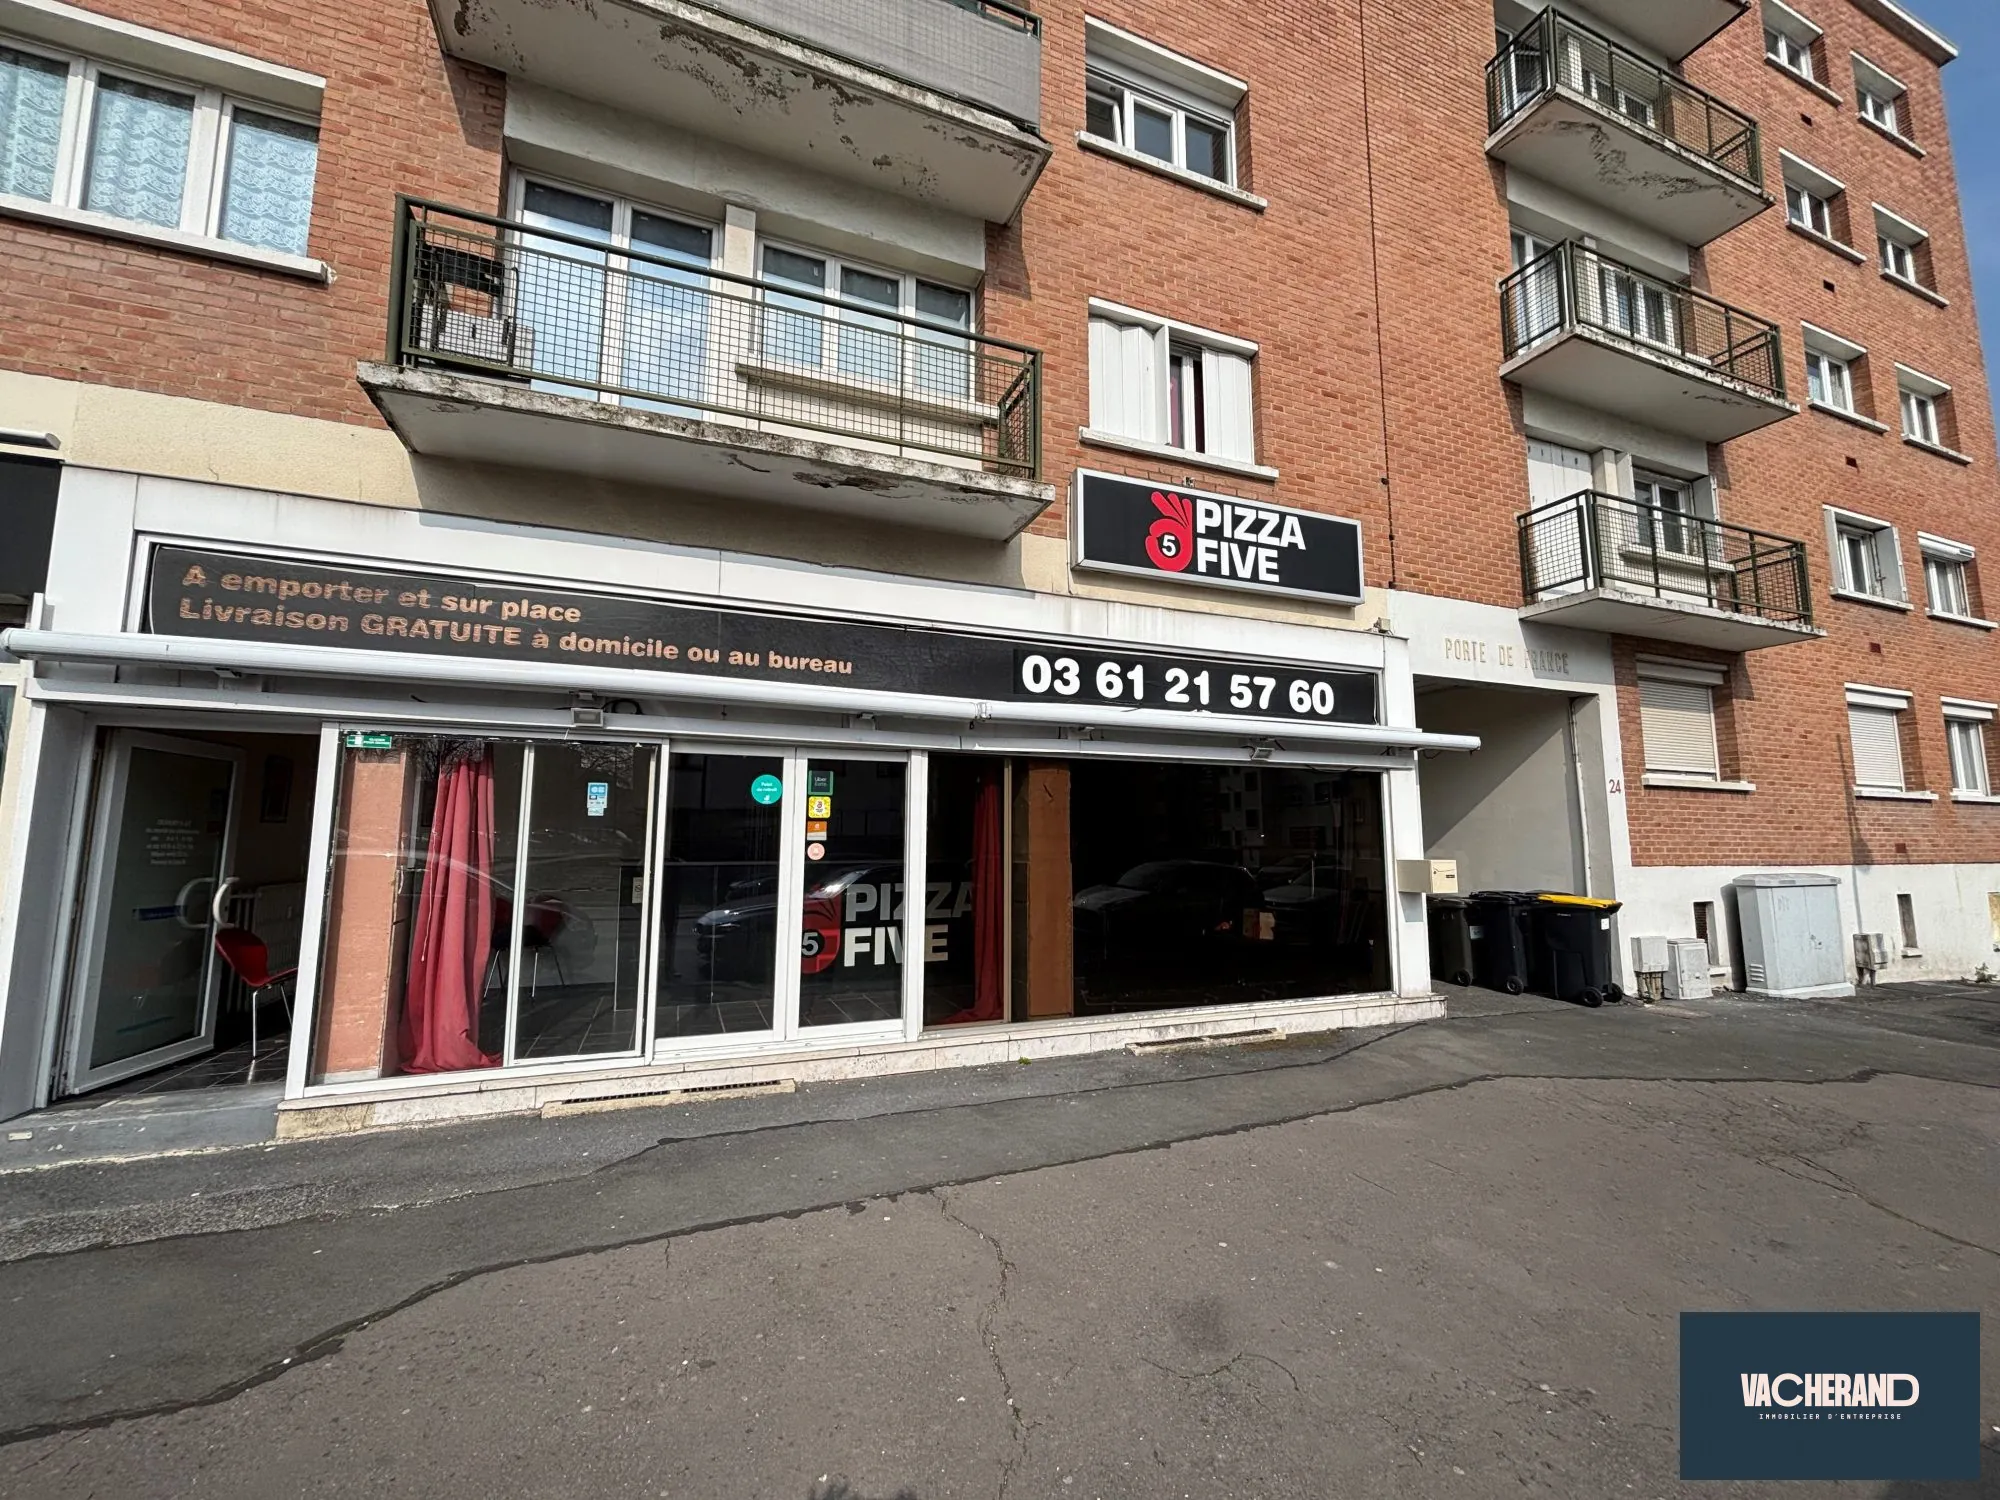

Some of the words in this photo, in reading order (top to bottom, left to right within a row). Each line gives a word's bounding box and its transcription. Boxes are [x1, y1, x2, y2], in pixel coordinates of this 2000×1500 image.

[1161, 534, 1177, 557] 5
[1196, 498, 1307, 551] PIZZA
[1196, 537, 1280, 583] FIVE
[182, 565, 207, 588] A
[220, 573, 390, 604] emporter
[398, 589, 432, 609] et
[441, 595, 494, 615] sur
[501, 599, 583, 623] place
[179, 598, 350, 632] Livraison
[360, 613, 522, 646] GRATUITE
[531, 627, 550, 649] à
[559, 632, 680, 661] domicile
[687, 646, 720, 664] ou
[728, 648, 760, 667] au
[768, 650, 853, 674] bureau
[1444, 638, 1487, 664] PORTE
[1498, 645, 1514, 667] DE
[1523, 649, 1570, 675] FRANCE
[1022, 654, 1081, 696] 03
[1096, 661, 1145, 700] 61
[1164, 667, 1210, 706] 21
[1230, 674, 1277, 710] 57
[1289, 680, 1335, 715] 60
[1608, 779, 1621, 794] 24
[801, 931, 819, 956] 5
